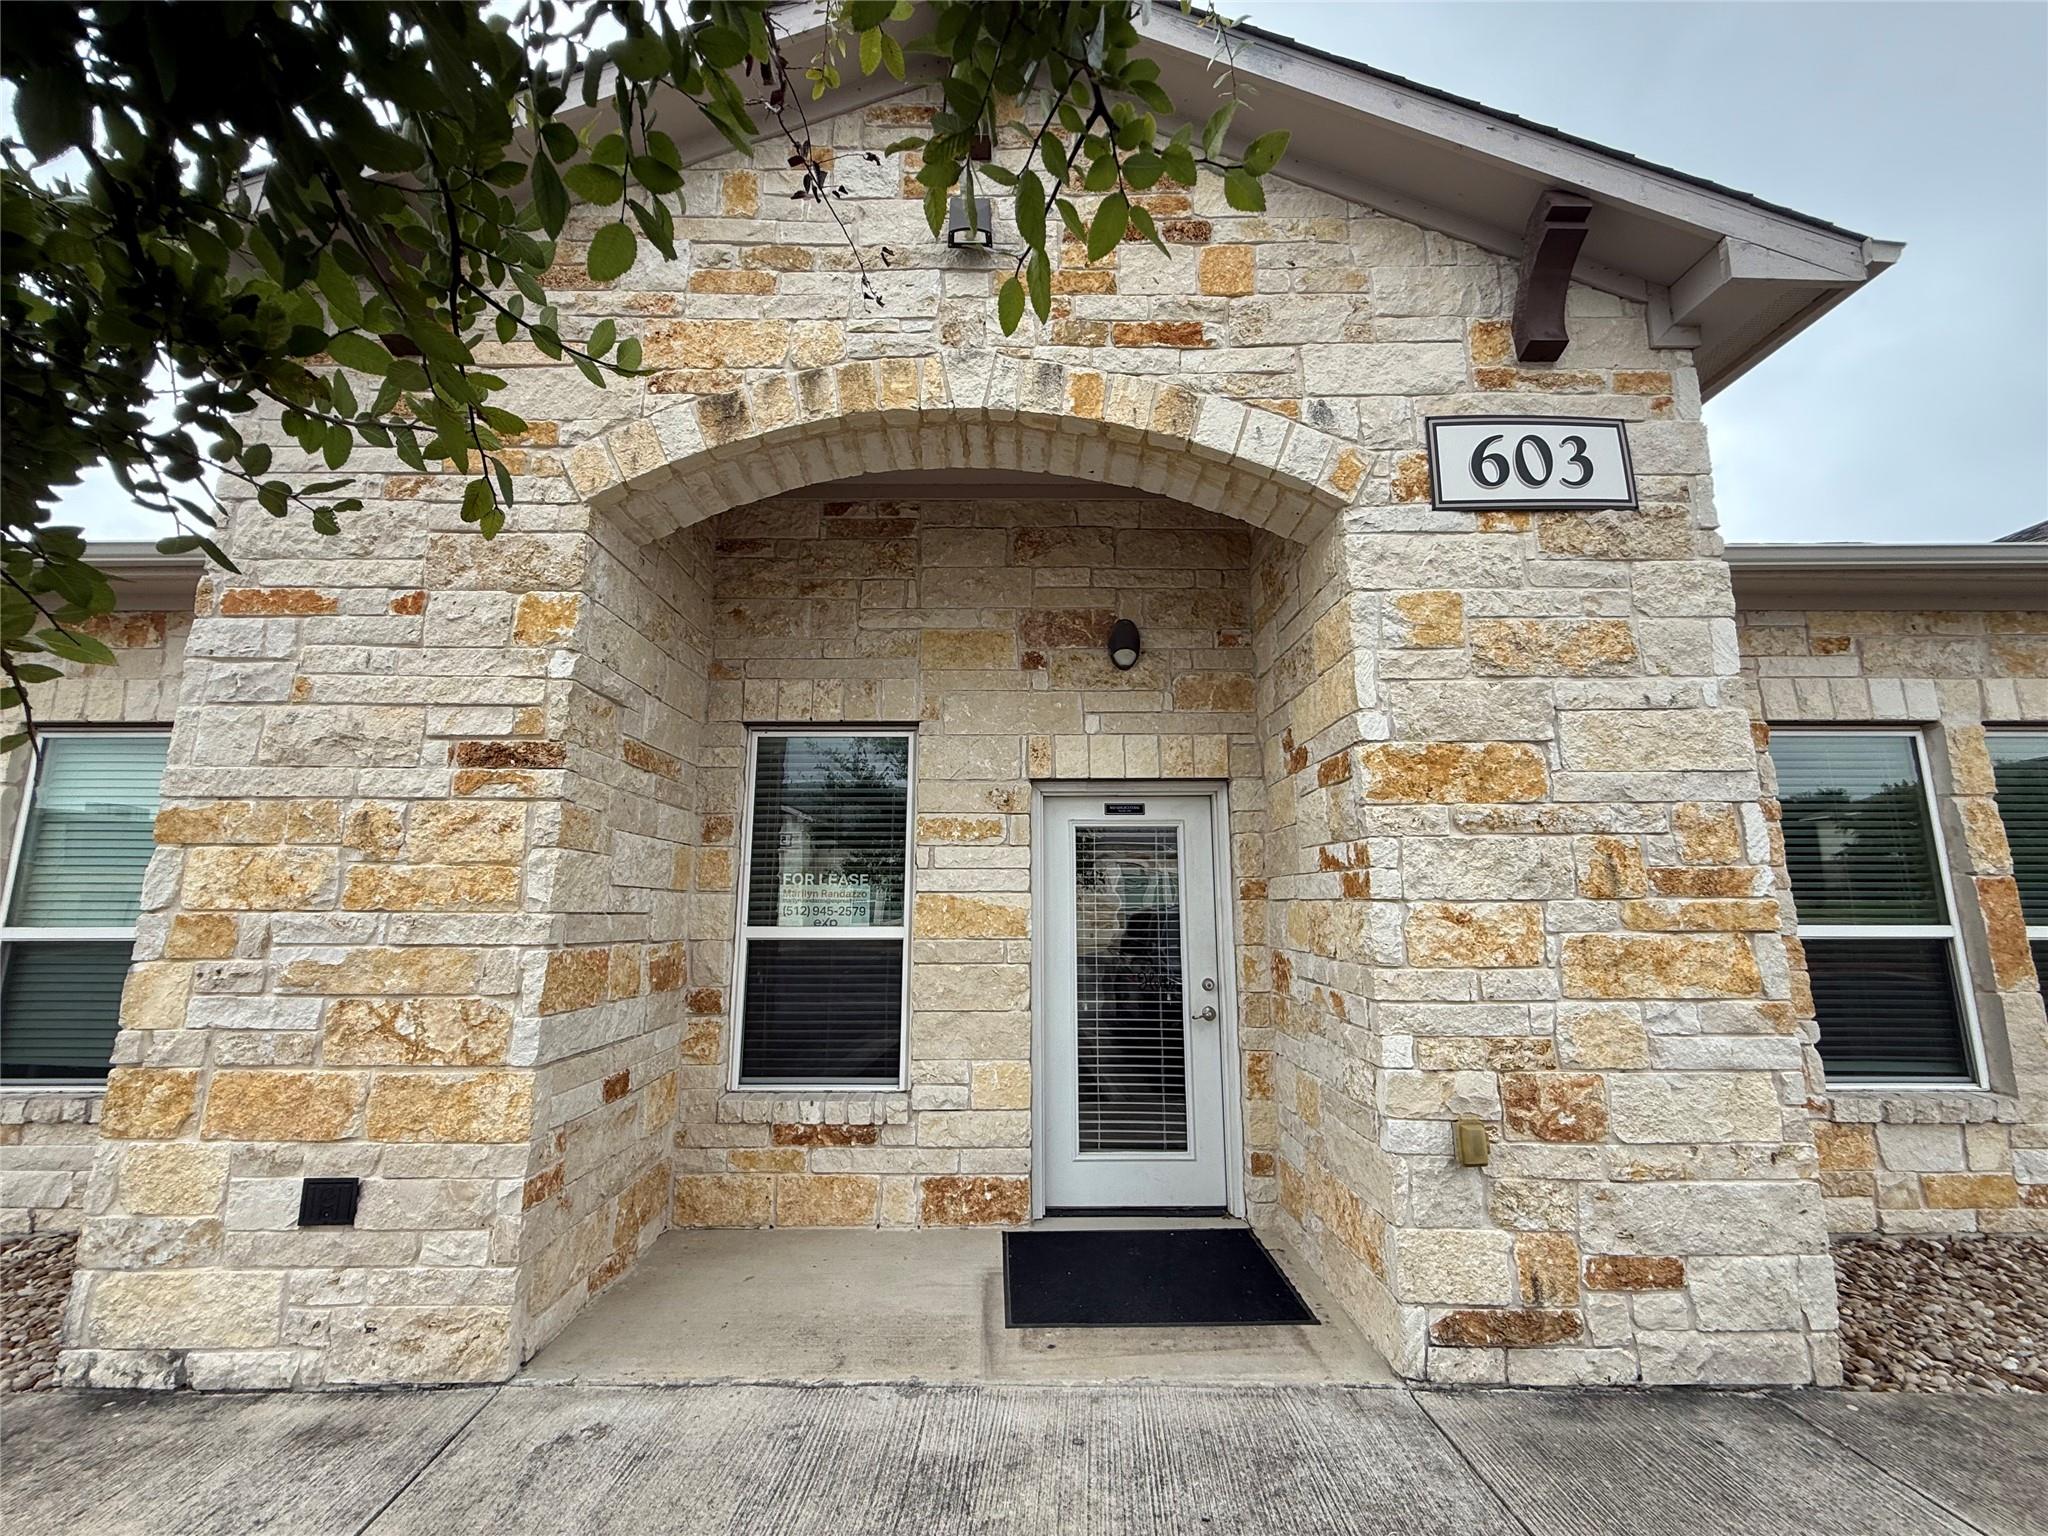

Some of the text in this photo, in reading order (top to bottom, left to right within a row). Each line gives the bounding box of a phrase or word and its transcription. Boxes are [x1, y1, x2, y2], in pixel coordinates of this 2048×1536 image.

[1469, 434, 1594, 489] 603
[783, 873, 869, 886] FOR LEASE
[783, 889, 867, 899] Marilyn Randazzo
[783, 906, 866, 917] (512) 945-2579
